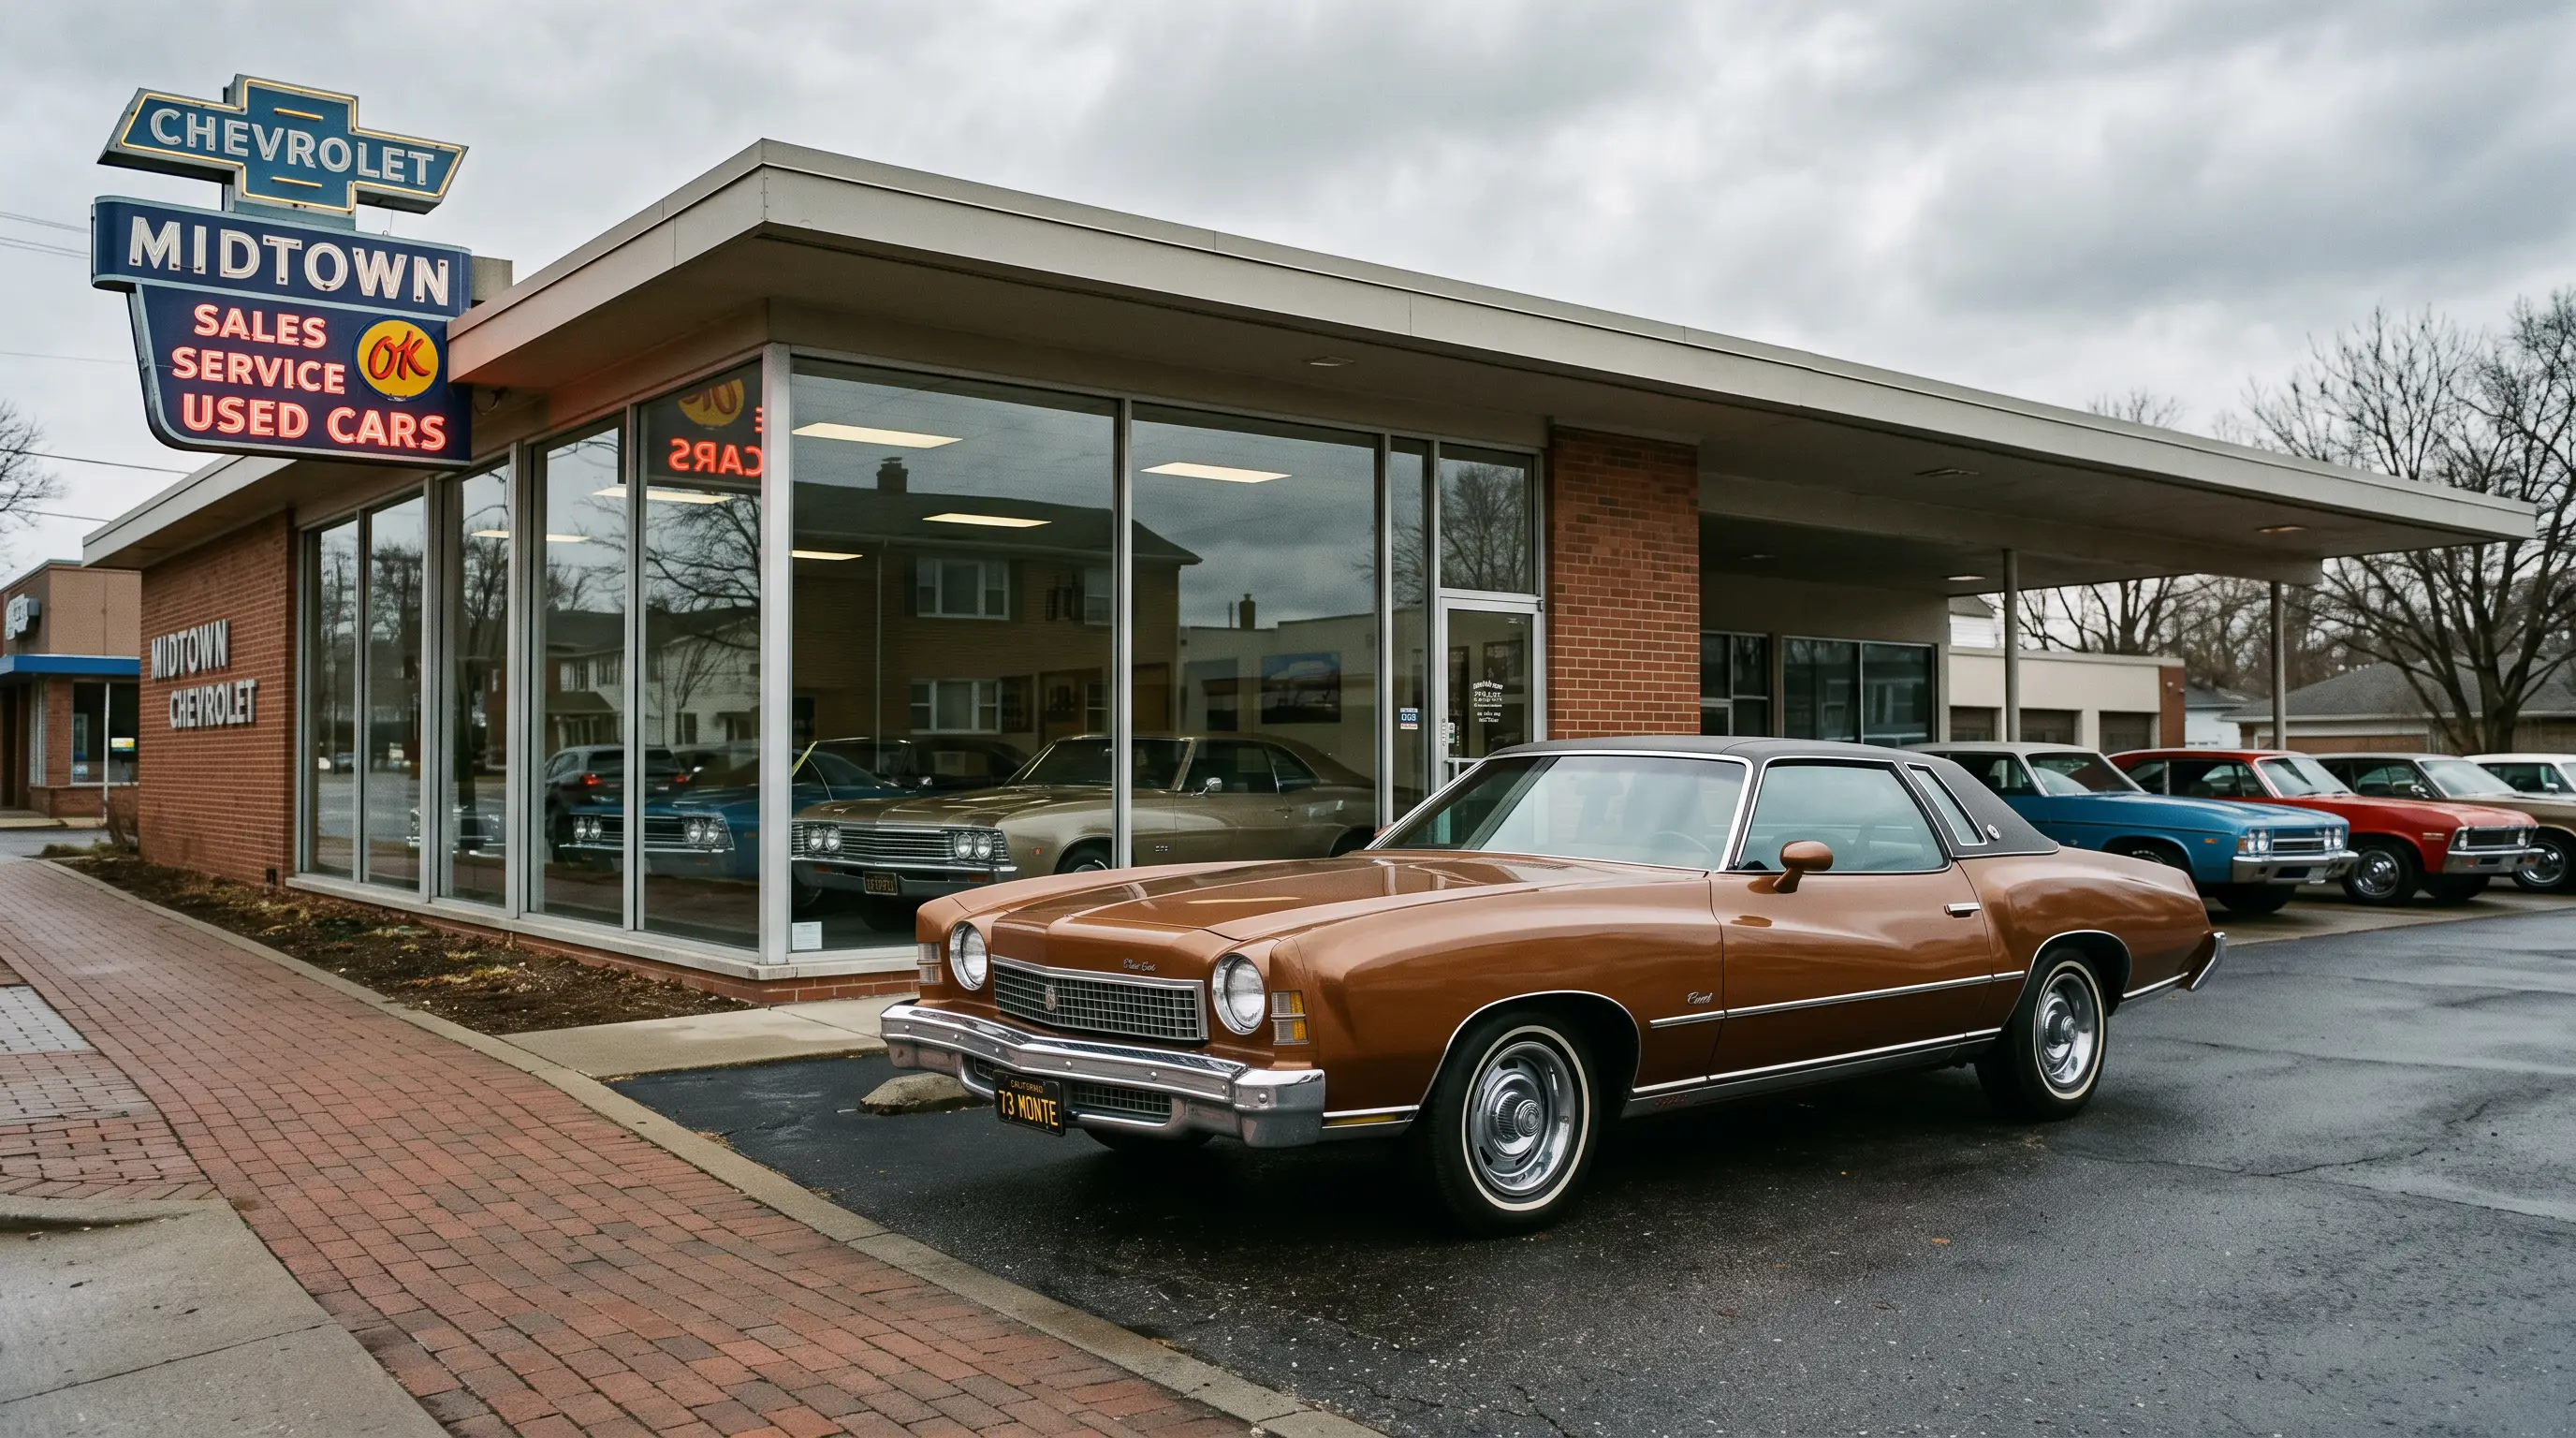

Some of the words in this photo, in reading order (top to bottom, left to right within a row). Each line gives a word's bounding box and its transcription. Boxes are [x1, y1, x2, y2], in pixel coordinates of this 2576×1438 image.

[150, 108, 434, 185] CHEVROLET
[128, 215, 449, 307] MIDTOWN
[194, 303, 328, 349] SALES
[171, 346, 345, 395] SERVICE
[368, 330, 431, 381] OK
[183, 393, 309, 439] USED
[328, 406, 446, 451] CARS
[151, 618, 229, 681] MIDTOWN
[169, 678, 257, 729] CHEVROLET
[999, 1090, 1015, 1115] 73
[1017, 1093, 1059, 1126] MONTE
